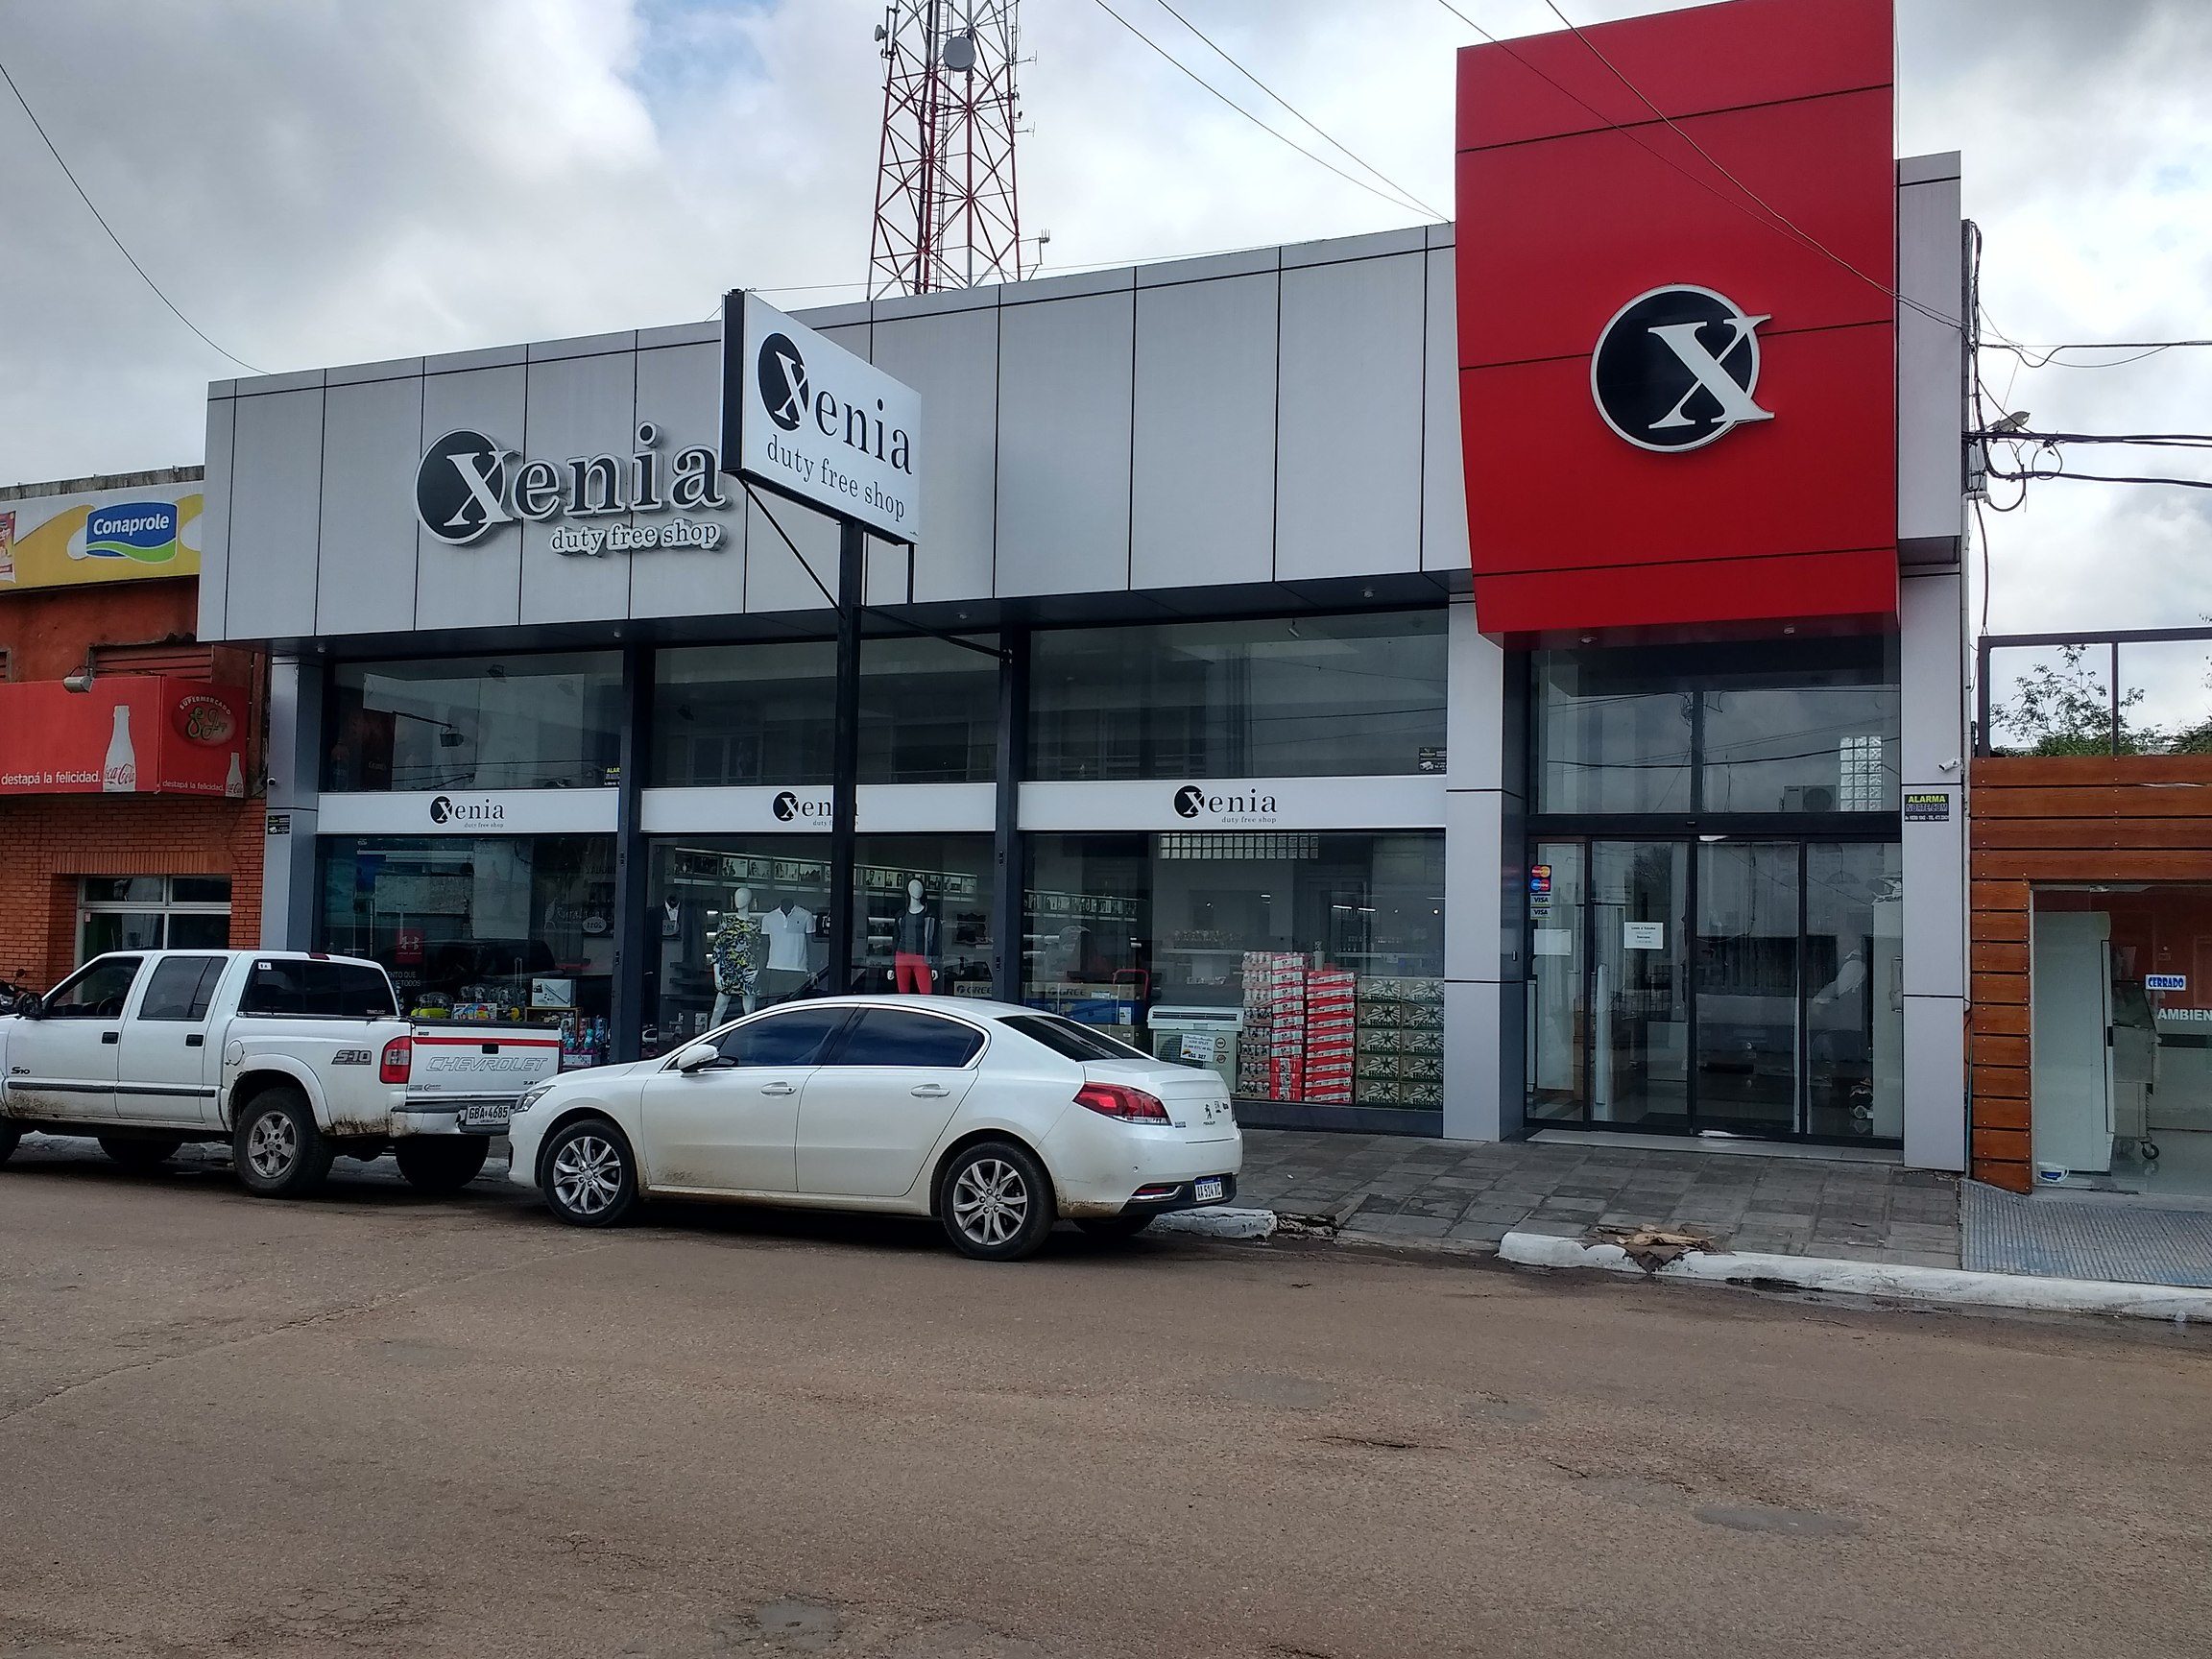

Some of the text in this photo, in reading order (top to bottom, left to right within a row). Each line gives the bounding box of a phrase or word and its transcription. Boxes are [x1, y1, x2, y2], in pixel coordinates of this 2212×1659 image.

[758, 333, 913, 474] Xenia
[416, 422, 728, 544] Xenia
[767, 433, 905, 523] duty free shop
[93, 514, 170, 537] Conaprole
[551, 521, 717, 552] duty free shop
[179, 695, 232, 715] SUPERMERCADO
[1, 770, 102, 786] destapá la felicidad.
[430, 795, 505, 824] Xenia
[773, 791, 859, 822] Xen
[1174, 785, 1278, 818] Xenia
[1908, 795, 1946, 804] ALARMA
[2148, 976, 2184, 988] CERRADO
[2157, 1008, 2212, 1022] AMBIEN
[11, 1066, 31, 1075] S10
[426, 1056, 548, 1071] CHEVROLET
[469, 1106, 509, 1119] GBA 4685
